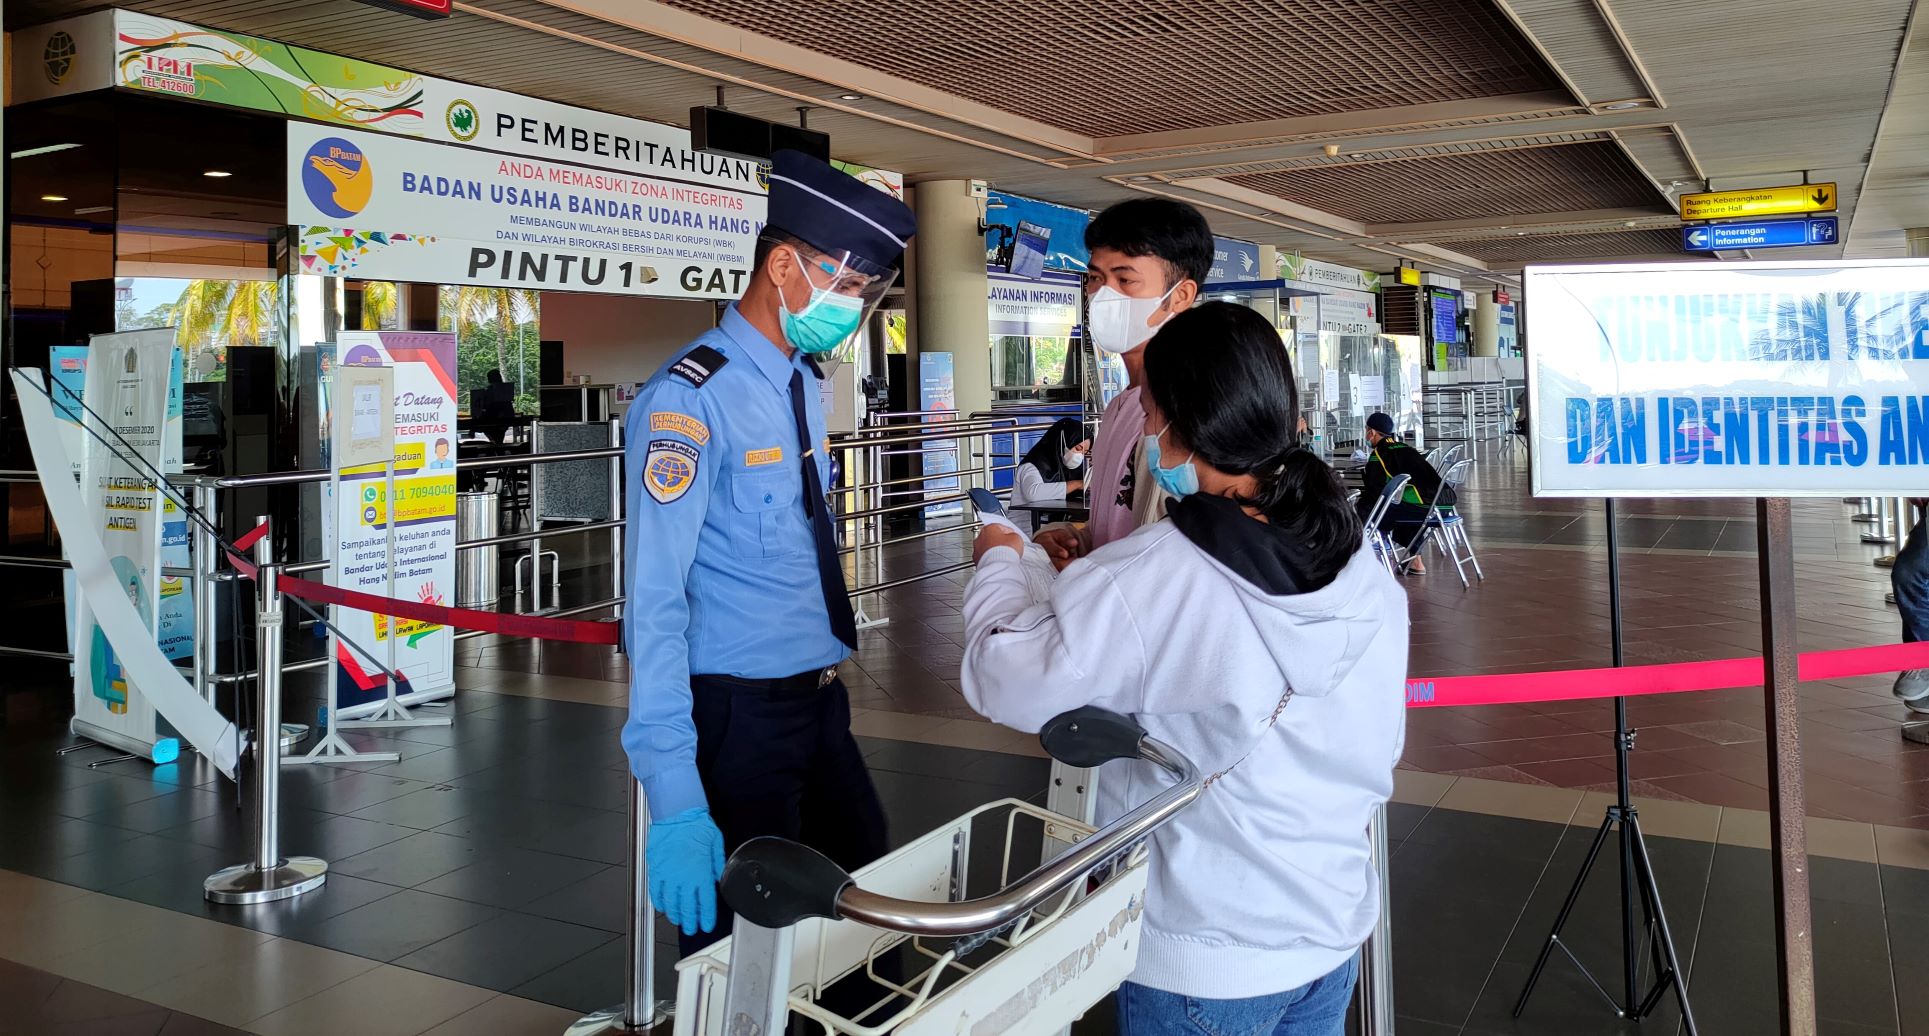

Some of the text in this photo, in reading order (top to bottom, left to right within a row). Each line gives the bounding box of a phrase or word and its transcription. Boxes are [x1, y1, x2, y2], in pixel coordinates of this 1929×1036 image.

[160, 79, 194, 94] 412600
[496, 112, 750, 182] PEMBERITAHUAN
[498, 161, 744, 211] ANDA MEMASUKI ZONA INTEGRITAS
[402, 171, 482, 201] BADAN
[490, 184, 562, 212] USAHA
[568, 194, 643, 222] BANDAR
[648, 206, 704, 229] UDARA
[708, 214, 750, 235] HANG
[1686, 193, 1773, 207] Ruang Keberangkatan
[1686, 204, 1743, 215] Departure Hall
[510, 215, 736, 251] MEMBANGUN WILAYAH BEBAS DARI KORUPSI (WBK)
[1715, 227, 1766, 237] Penerangan
[496, 230, 745, 265] DAN WILAYAH BIROKRASI BERSIH DAN MELAYANI (WBBM)
[1715, 236, 1765, 246] Information
[467, 247, 754, 295] PINTU 1 GAT
[1030, 289, 1075, 306] INFORMASI
[672, 364, 704, 383] AVSEC
[403, 392, 444, 409] Datang
[395, 412, 439, 424] EMASUKI
[654, 414, 709, 438] KEMENTERIAN
[394, 424, 448, 436] TEGRITAS
[1565, 396, 1648, 465] DAN
[1656, 394, 1869, 467] IDENTITAS
[652, 442, 698, 458] PERHUBUNGAN
[380, 484, 455, 503] 011 7094040
[135, 497, 153, 509] TEST
[108, 516, 137, 529] ANTIGEN
[399, 531, 430, 543] keluhan
[431, 527, 451, 537] anda
[355, 541, 437, 561] tentang elayanan di
[344, 564, 373, 576] Bandar
[399, 552, 447, 566] Internasional
[359, 576, 380, 586] Hang
[409, 568, 433, 578] Batam
